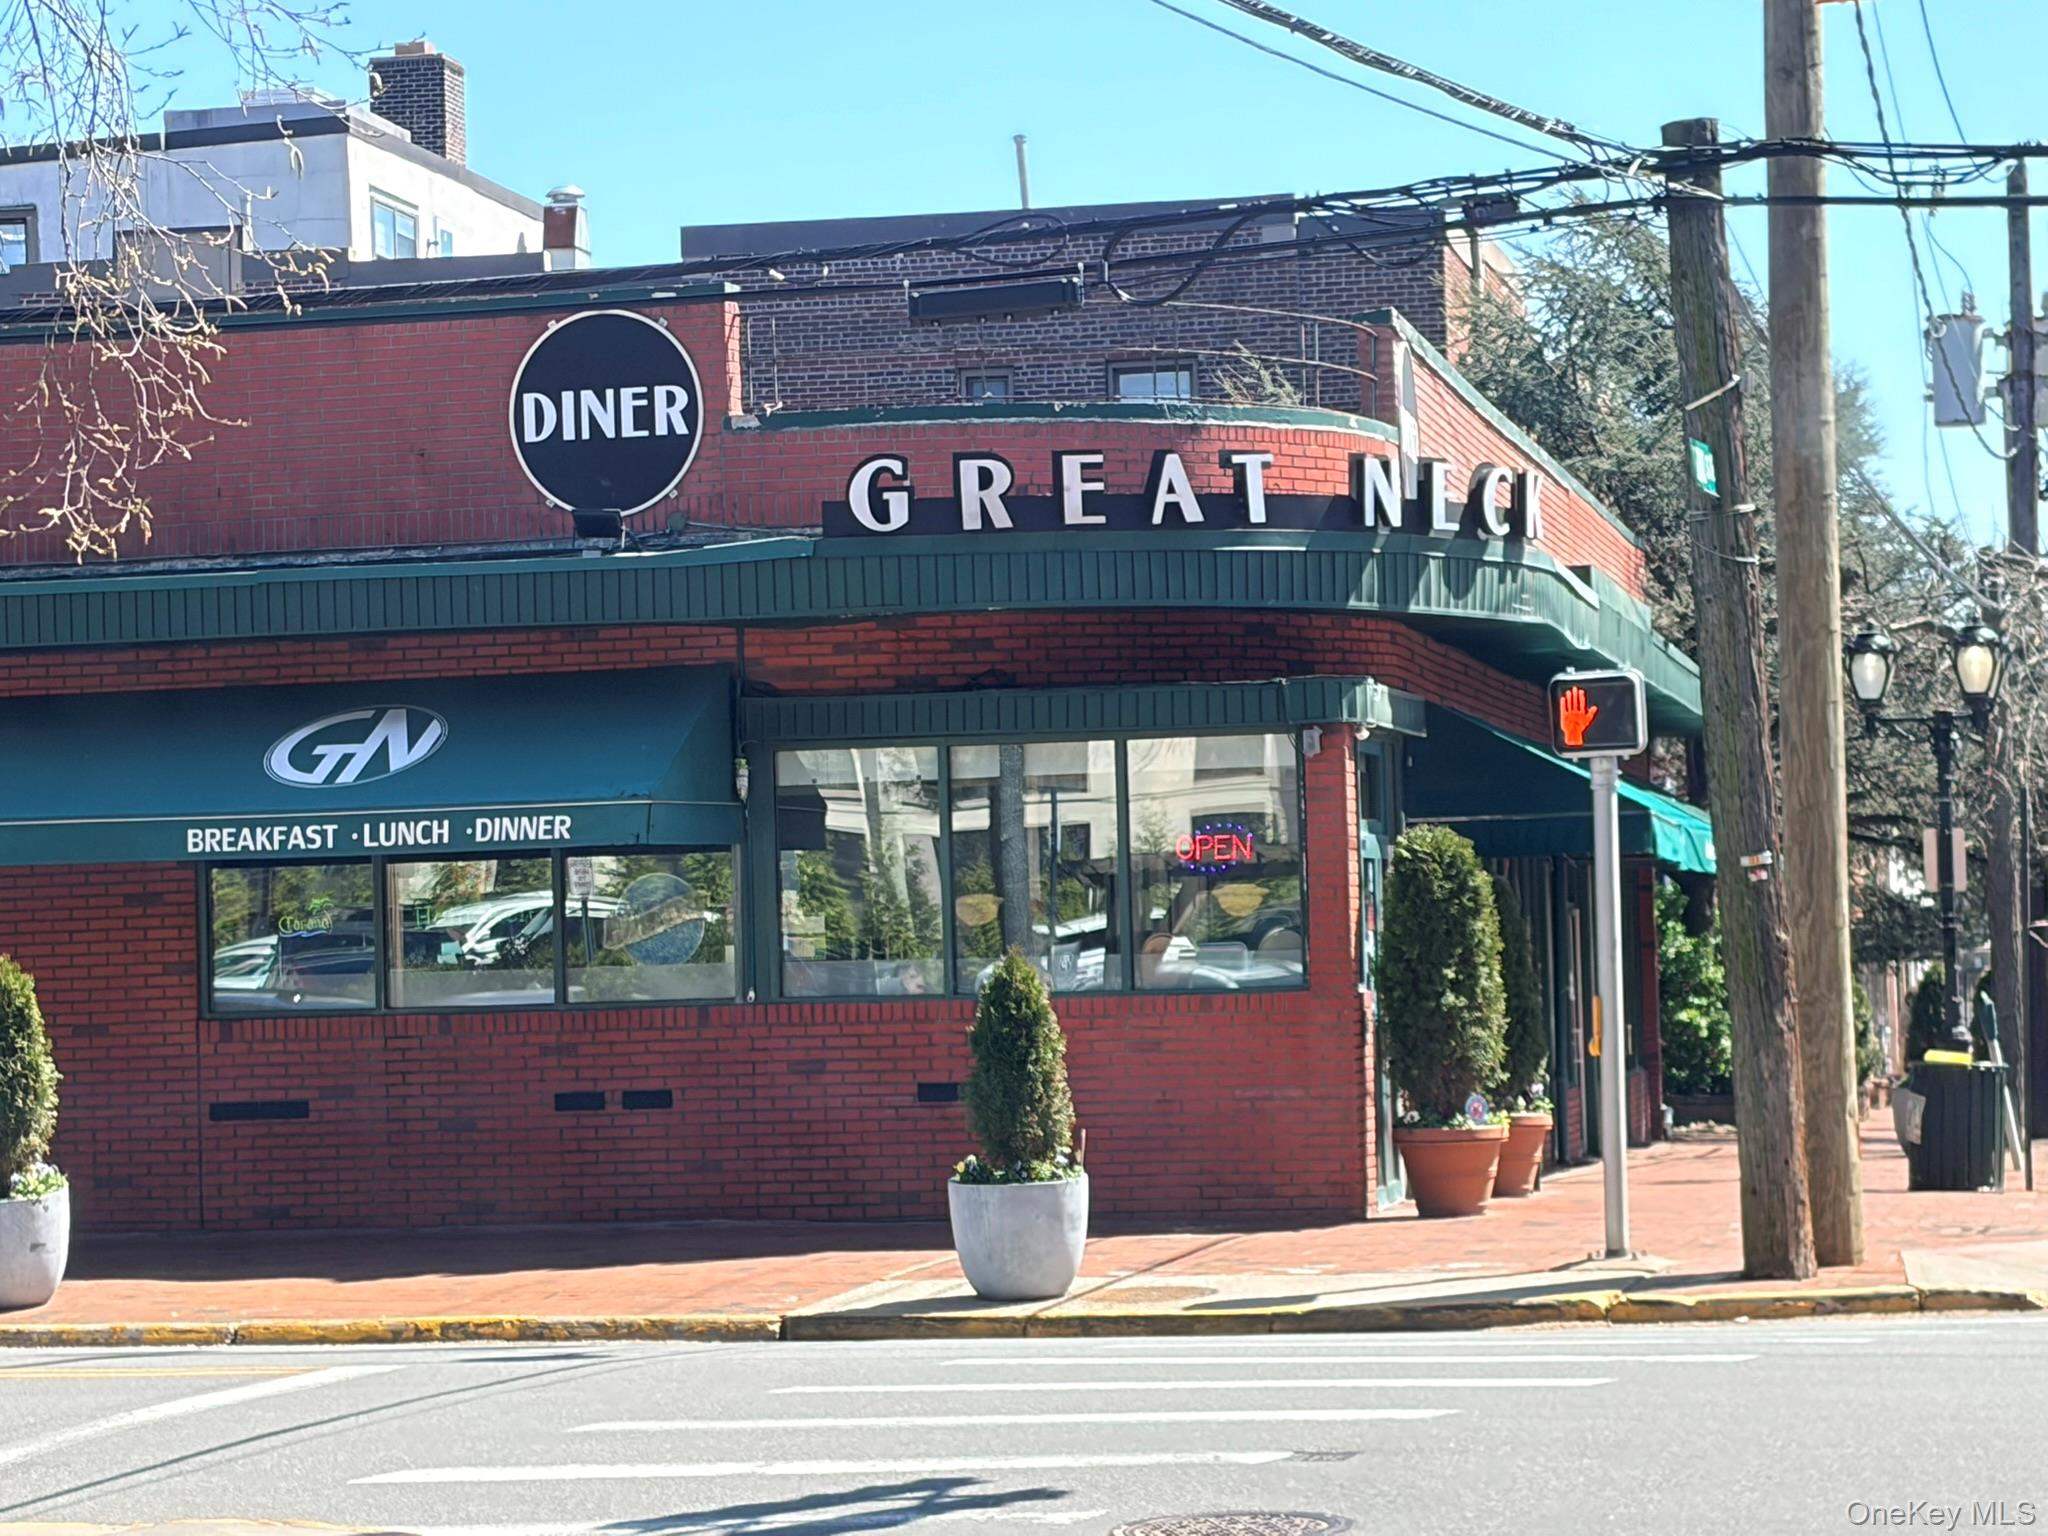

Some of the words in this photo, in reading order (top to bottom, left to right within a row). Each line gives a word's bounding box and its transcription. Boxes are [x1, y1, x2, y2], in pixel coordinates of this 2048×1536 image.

[522, 385, 690, 443] DINER
[848, 452, 1272, 534] GREAT
[1362, 454, 1545, 540] NECK
[187, 825, 338, 853] BREAKFAST
[1176, 834, 1252, 861] OPEN
